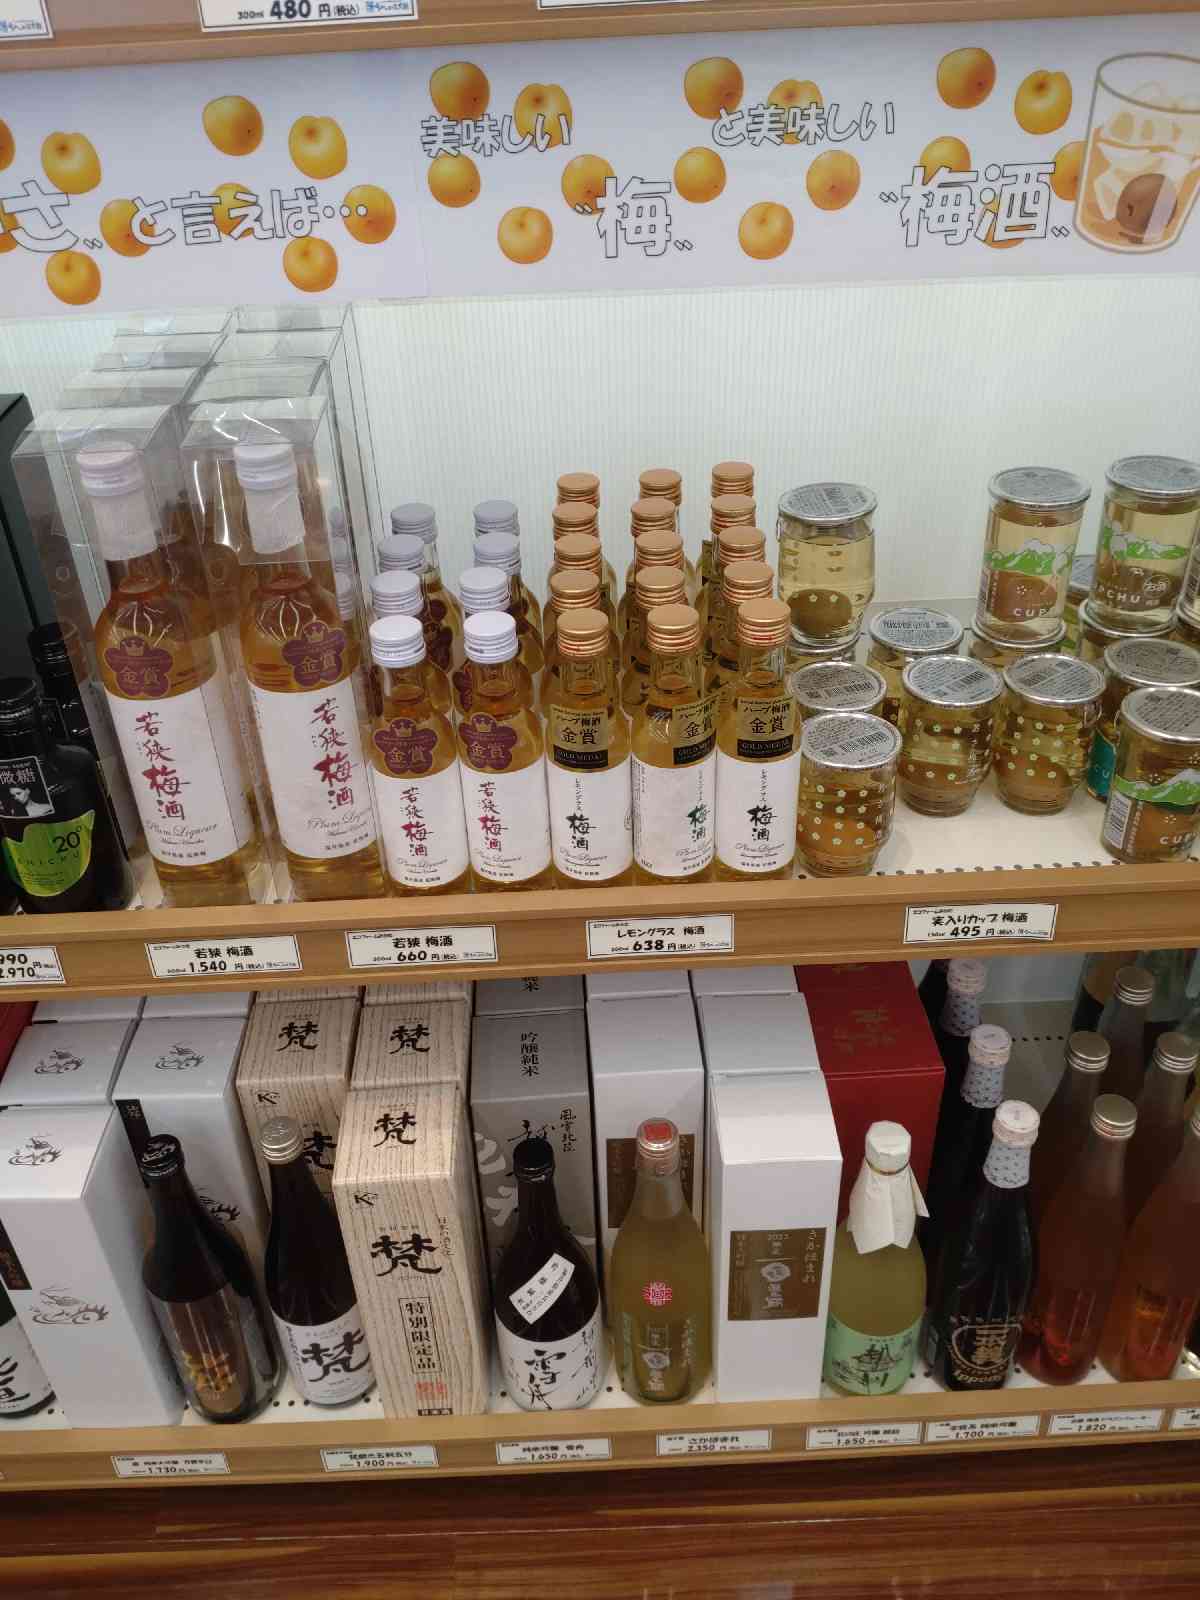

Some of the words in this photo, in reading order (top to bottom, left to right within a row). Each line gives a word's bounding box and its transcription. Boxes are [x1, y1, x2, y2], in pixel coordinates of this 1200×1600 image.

[269, 0, 311, 20] 480
[420, 113, 571, 158] 美味しい
[711, 102, 895, 147] と美味しい
[750, 715, 785, 735] 金賞
[565, 812, 600, 852] 梅酒
[746, 803, 778, 842] 梅酒
[392, 936, 421, 949] 若狭
[425, 935, 453, 947] 梅酒
[616, 927, 676, 938] レモングラス
[632, 940, 665, 951] 638
[949, 926, 981, 937] 495
[194, 948, 222, 959] 若狭
[227, 945, 254, 957] 梅酒
[396, 950, 428, 962] 660
[276, 1021, 320, 1052] 梵
[389, 1023, 431, 1054] 梵
[373, 1111, 417, 1148] 梵
[370, 1232, 443, 1277] 梵
[301, 1327, 371, 1383] 梵
